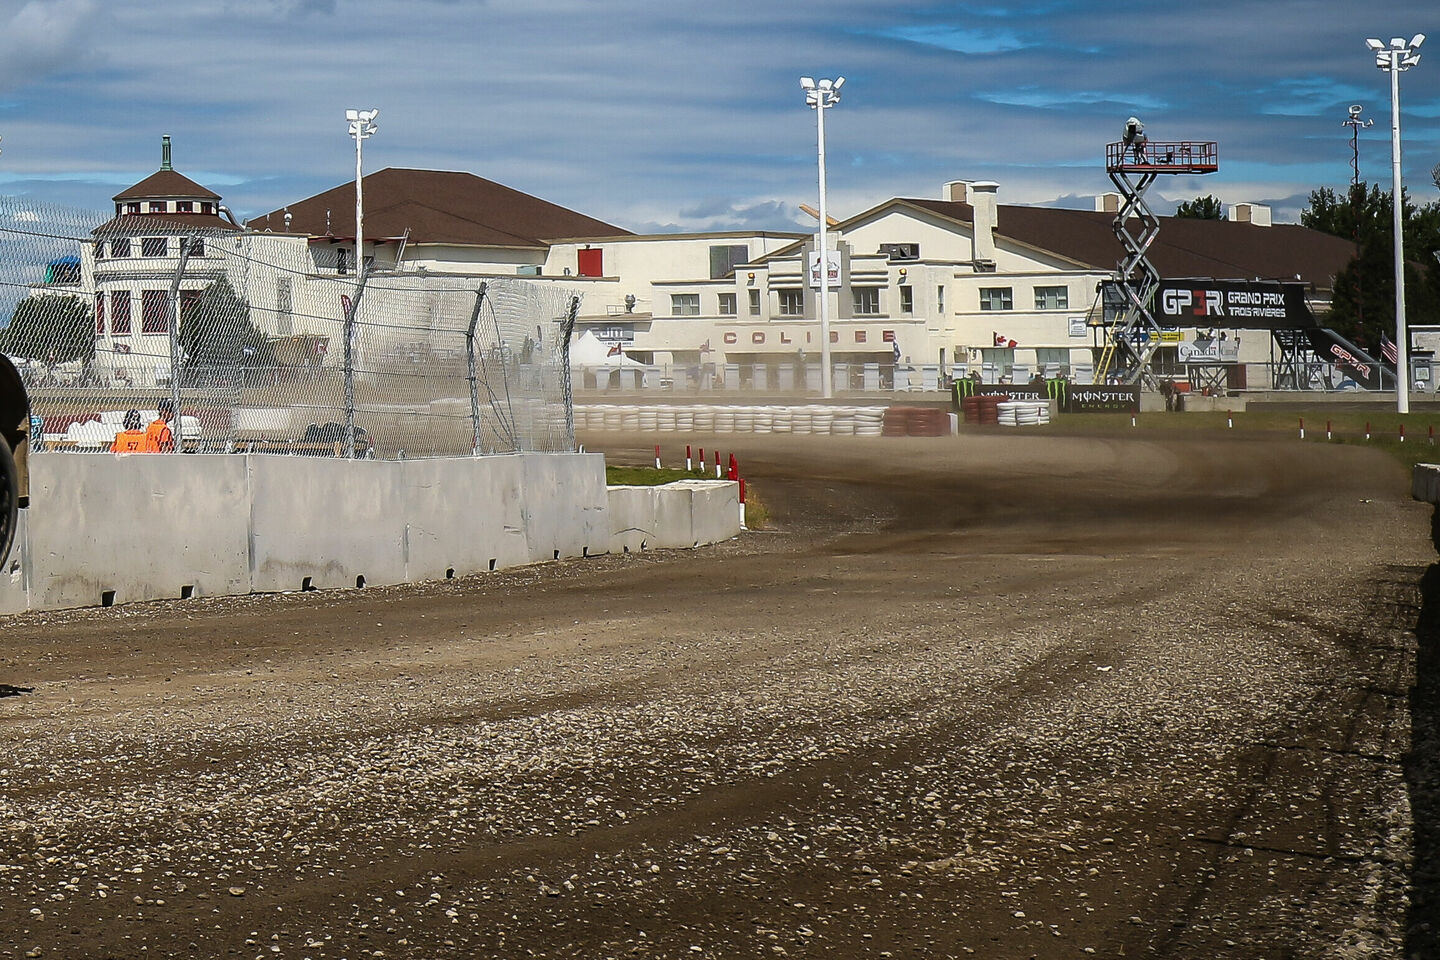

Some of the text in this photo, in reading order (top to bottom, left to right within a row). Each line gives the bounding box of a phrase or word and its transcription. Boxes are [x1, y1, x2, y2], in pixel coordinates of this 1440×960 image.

[1227, 291, 1261, 305] GRAND
[1263, 292, 1285, 306] PRIX
[1072, 390, 1135, 403] MONSTER
